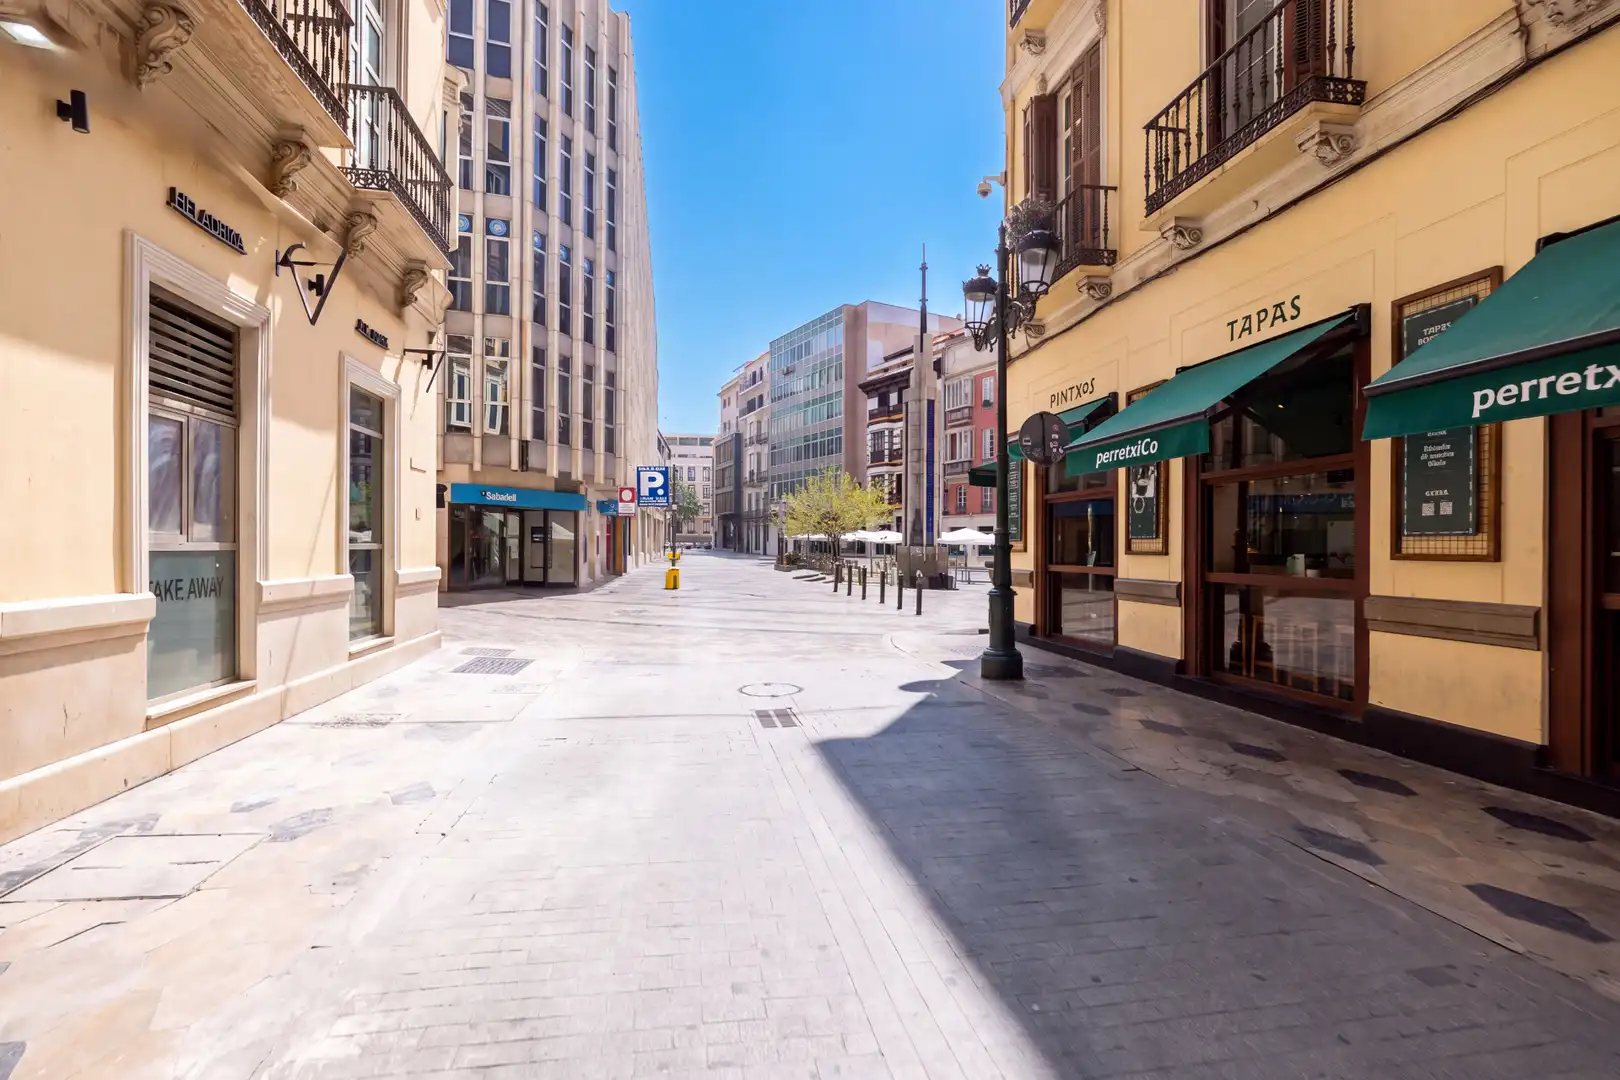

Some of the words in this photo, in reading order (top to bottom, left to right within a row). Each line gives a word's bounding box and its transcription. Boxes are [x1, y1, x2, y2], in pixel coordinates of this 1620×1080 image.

[1227, 294, 1301, 342] TAPAS
[1050, 377, 1095, 408] PINTXOS
[1095, 438, 1158, 468] perretxiCo
[486, 491, 517, 502] Sabadell
[187, 576, 224, 600] AWAY
